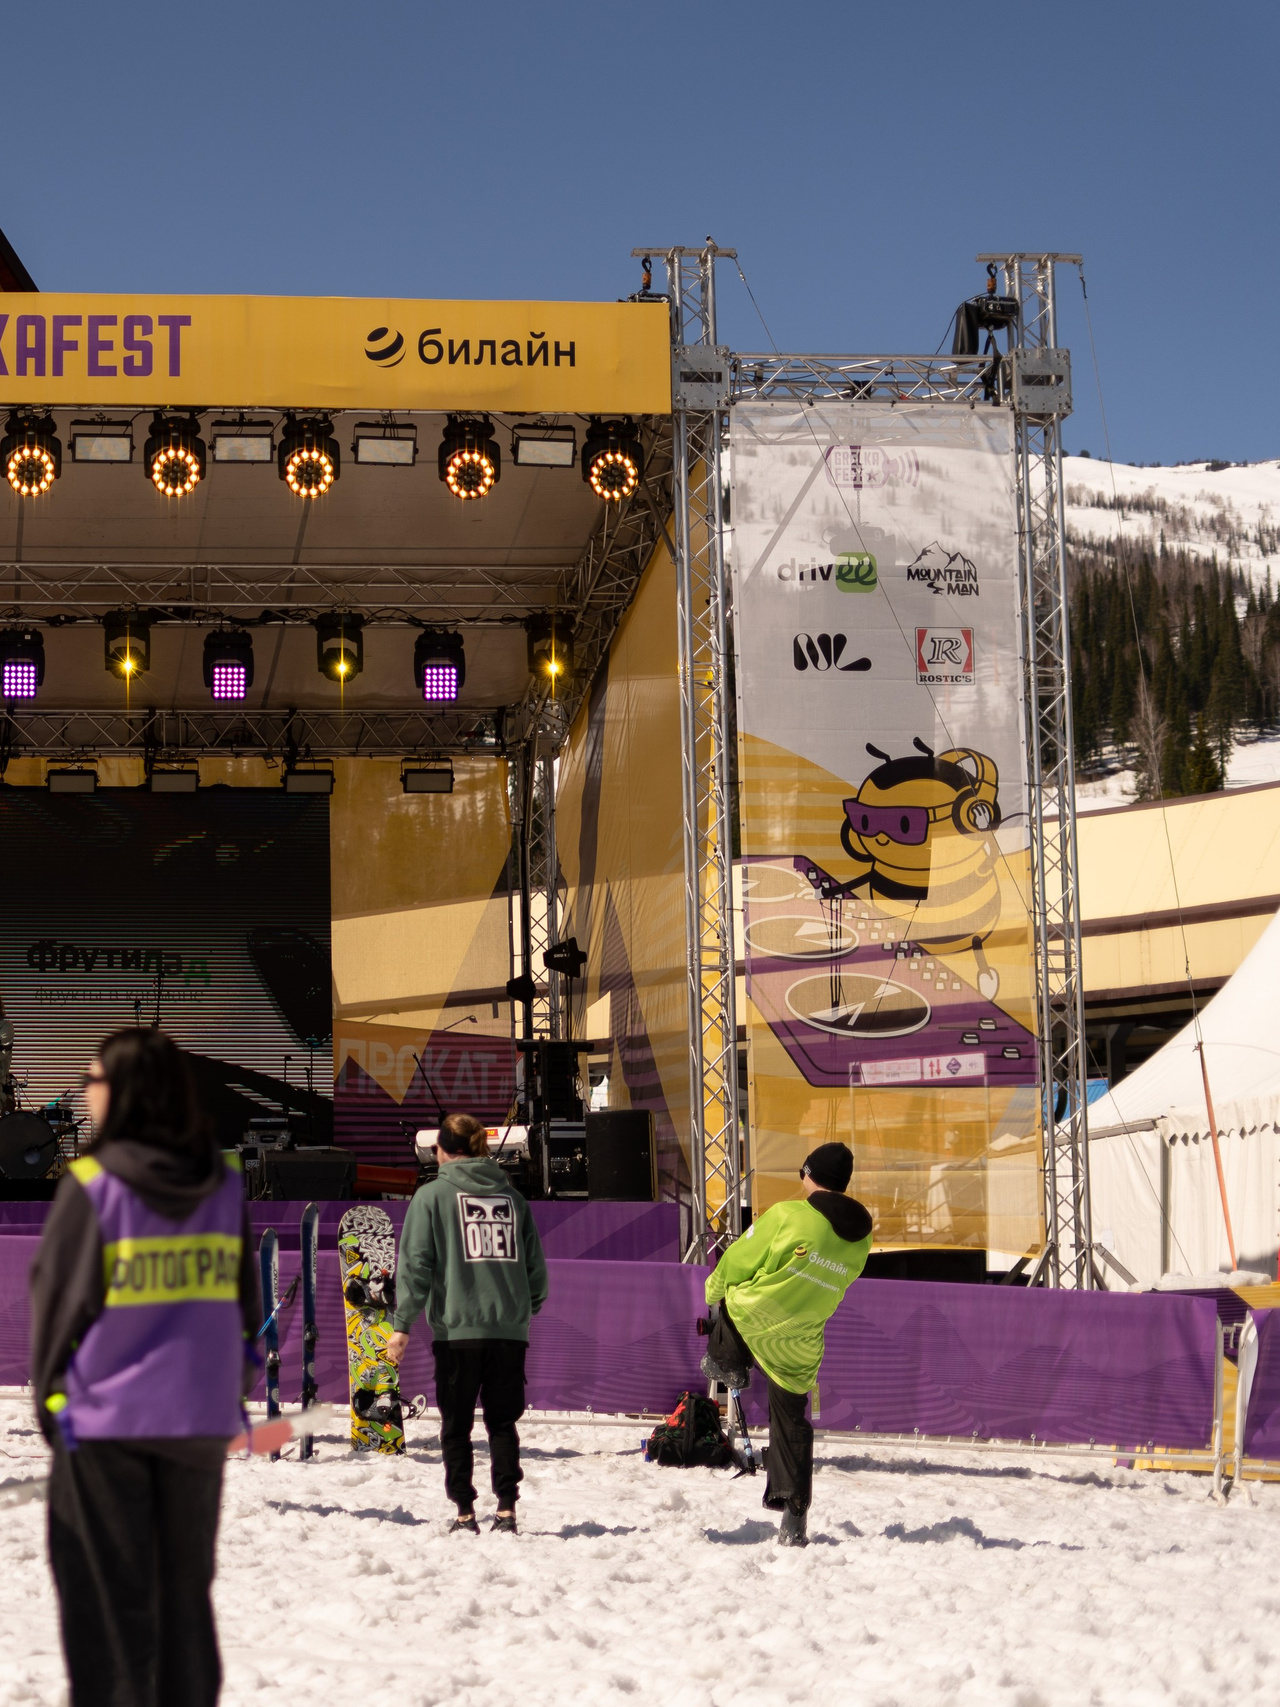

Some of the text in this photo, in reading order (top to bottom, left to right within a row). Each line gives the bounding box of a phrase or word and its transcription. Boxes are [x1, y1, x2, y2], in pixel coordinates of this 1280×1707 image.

[418, 327, 577, 368] билайн
[776, 555, 877, 586] drivee
[906, 567, 978, 582] MOUNTAIN
[947, 582, 980, 596] MAN
[919, 673, 973, 684] ROSTIC'S
[338, 1038, 498, 1105] ПРОКАТ
[466, 1221, 517, 1259] OBEY
[808, 1251, 848, 1276] билайн
